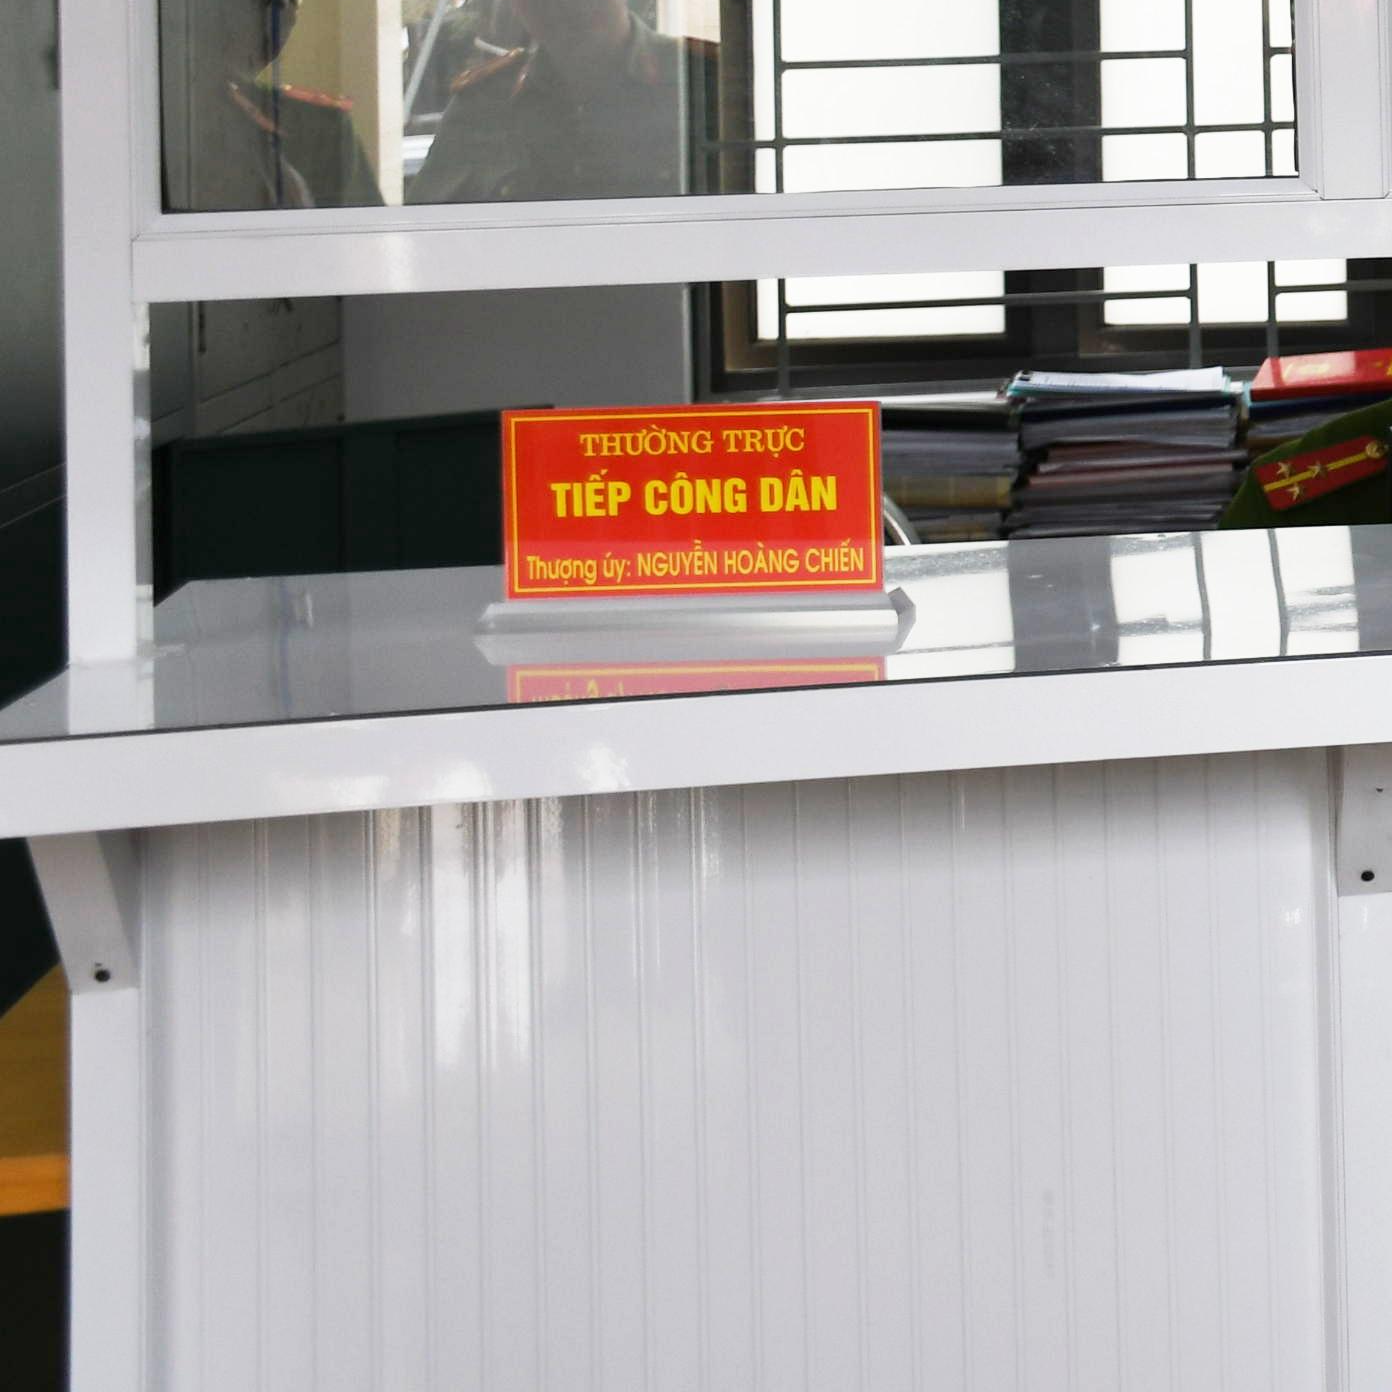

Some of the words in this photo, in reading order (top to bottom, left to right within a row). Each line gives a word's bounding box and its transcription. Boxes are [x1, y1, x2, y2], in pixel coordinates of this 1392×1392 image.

[580, 424, 713, 457] THƯỜNG
[723, 425, 805, 458] TRỰC
[551, 469, 631, 518] TIẾP
[645, 472, 747, 515] CÔNG
[760, 469, 837, 512] DÂN
[526, 555, 597, 585] Thượng
[603, 551, 631, 583] úy:
[724, 541, 800, 575] HOÀNG
[805, 538, 864, 573] CHIẾN
